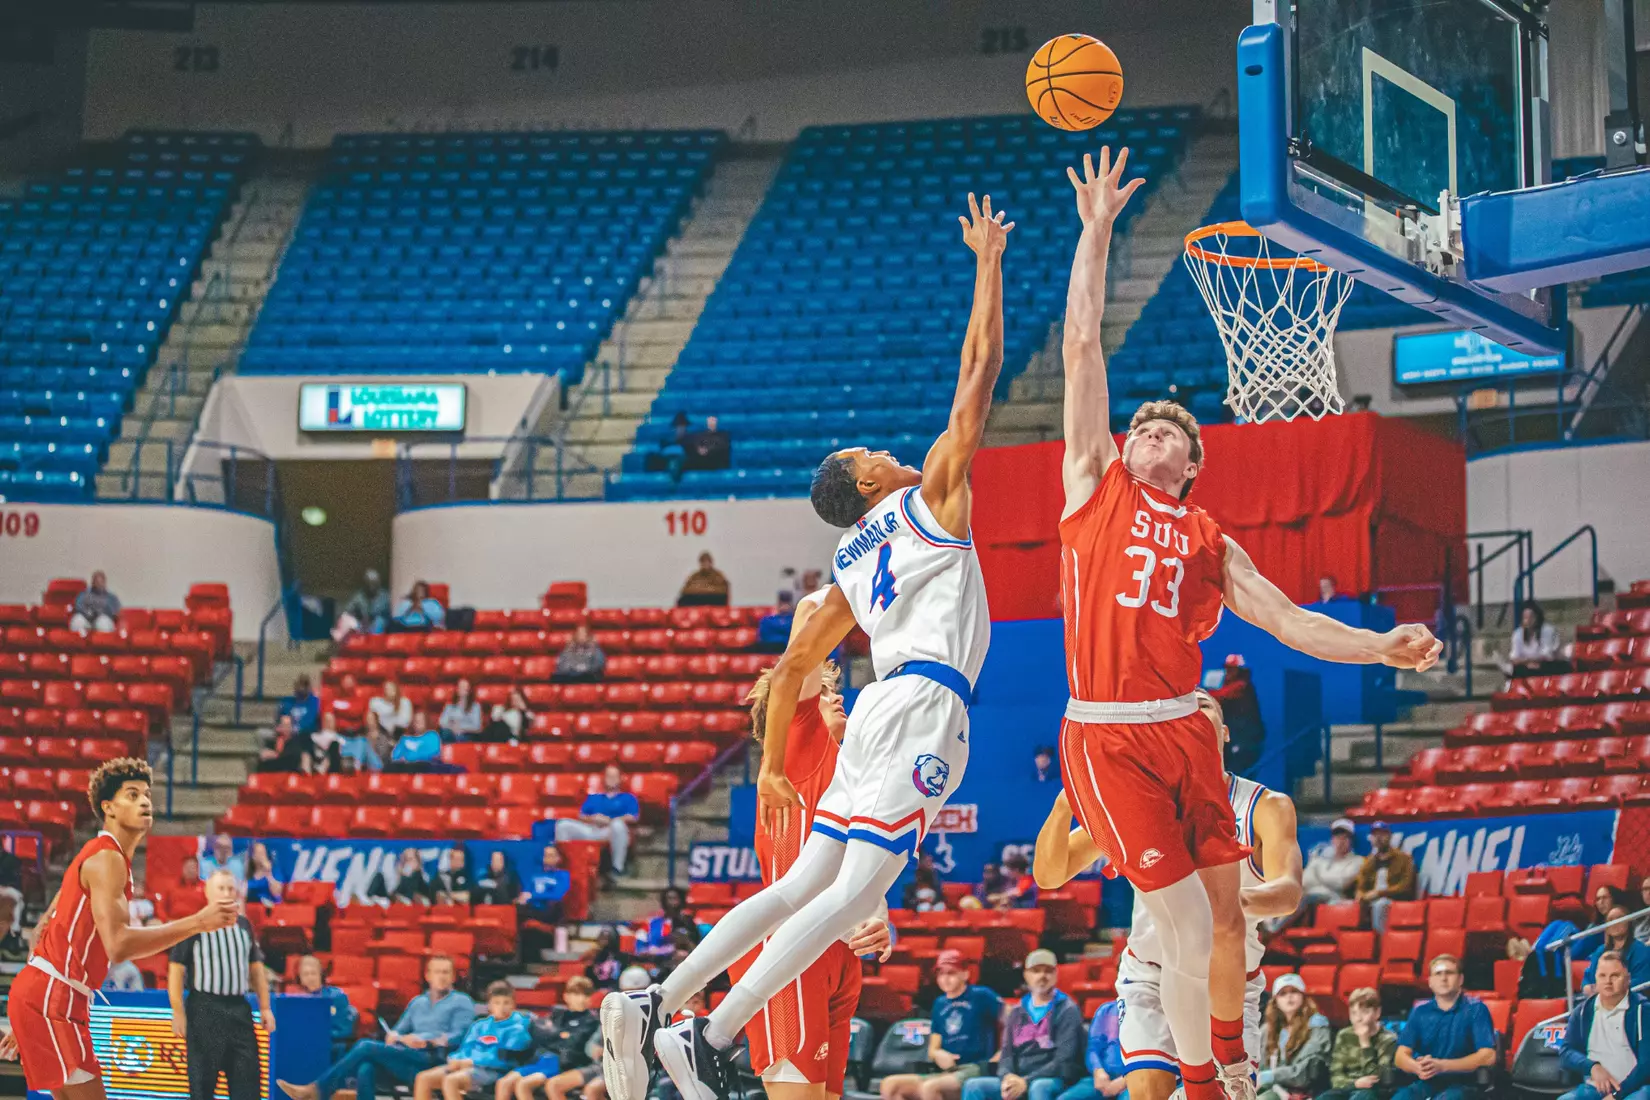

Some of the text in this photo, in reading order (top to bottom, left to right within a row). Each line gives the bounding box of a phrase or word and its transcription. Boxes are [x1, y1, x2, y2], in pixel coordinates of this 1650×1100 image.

[665, 510, 707, 536] 110
[883, 511, 900, 534] JR
[1130, 509, 1189, 556] SUU
[869, 541, 899, 614] 4
[1115, 546, 1185, 618] 33
